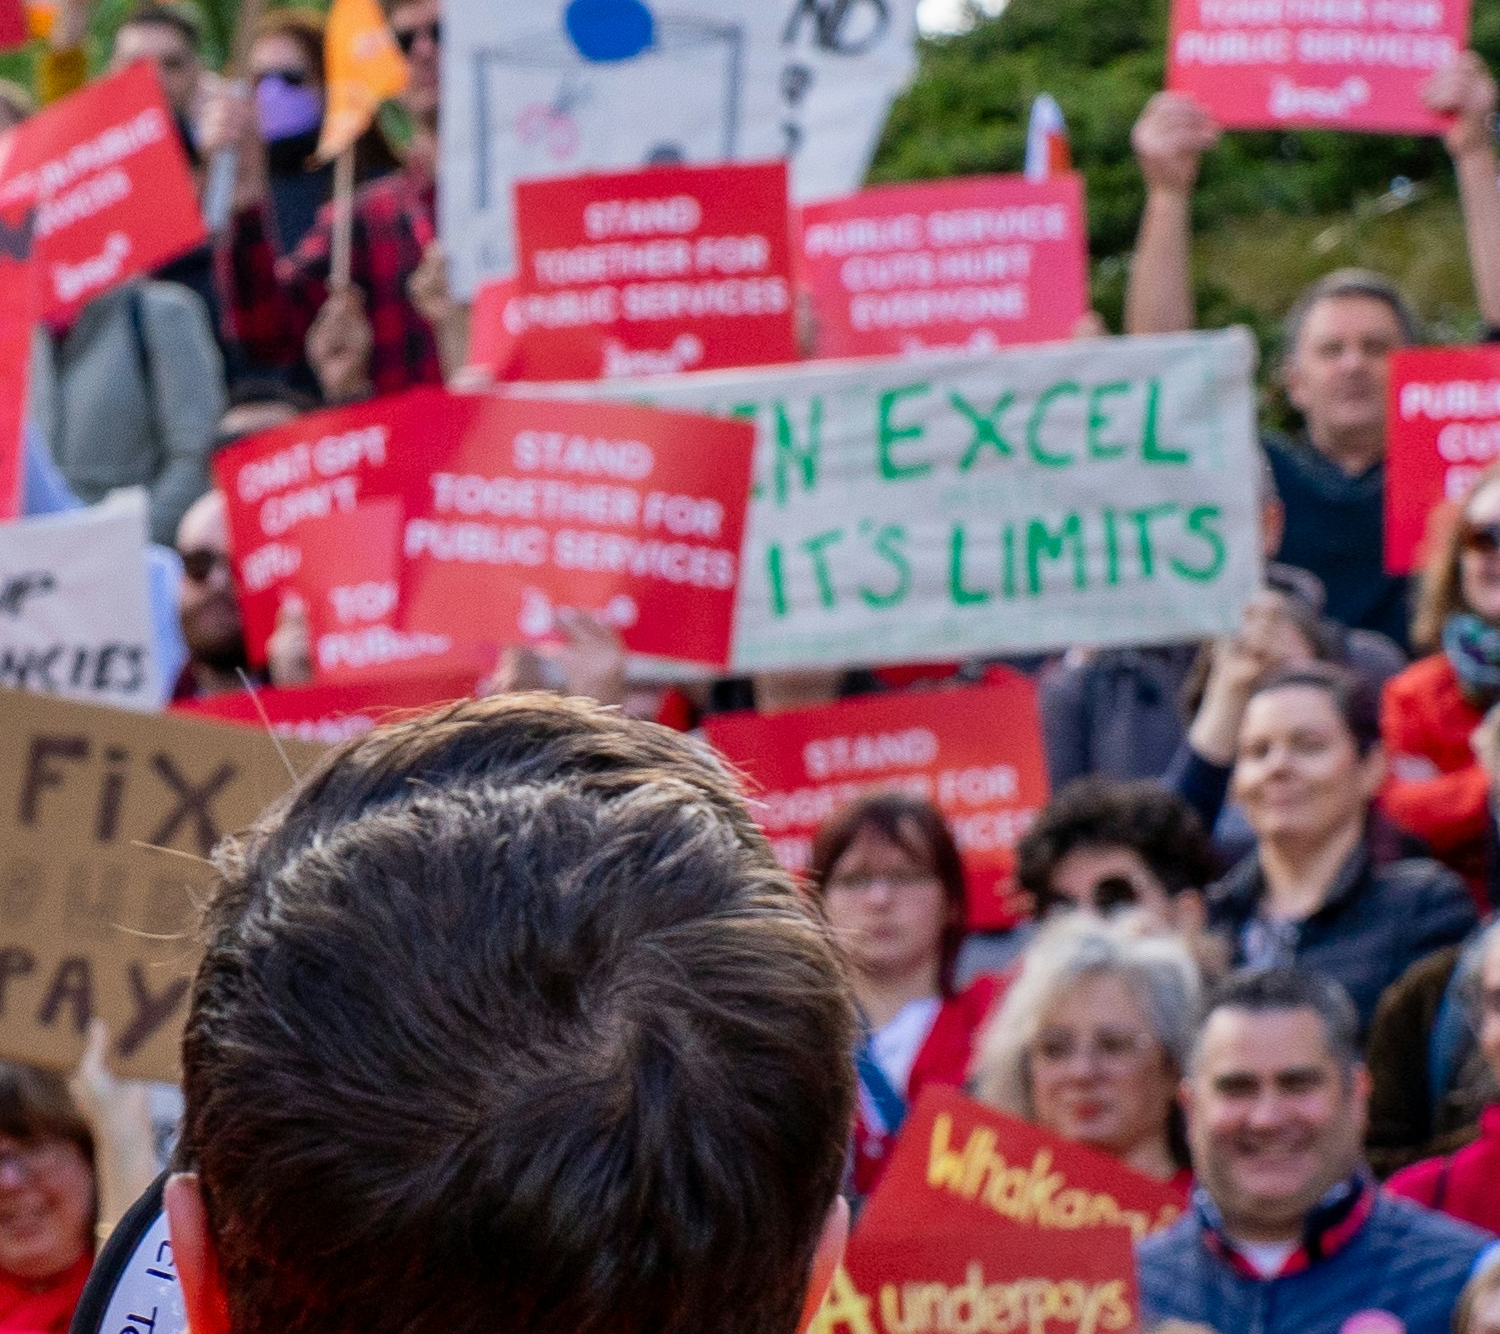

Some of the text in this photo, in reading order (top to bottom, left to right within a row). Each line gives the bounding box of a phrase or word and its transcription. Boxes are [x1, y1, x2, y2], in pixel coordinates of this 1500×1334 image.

[1179, 33, 1456, 67] PUBLIC SERVICES
[588, 200, 697, 237] STAND
[807, 206, 1069, 256] PUBLIC SERVICE
[535, 238, 766, 285] TOGETHER FOR
[842, 246, 1031, 289] CUTS HURT
[522, 281, 788, 330] PUBLIC SERVICES
[852, 287, 1027, 330] EVERYONE
[876, 377, 1190, 482] EXCEL
[516, 435, 653, 479] STAND
[434, 475, 722, 536] TOGETHER FOR
[406, 523, 735, 587] PUBLIC SERVICES
[767, 502, 1228, 619] IT'S LIMITS
[805, 728, 939, 778] STAND
[938, 767, 1018, 807] FOR
